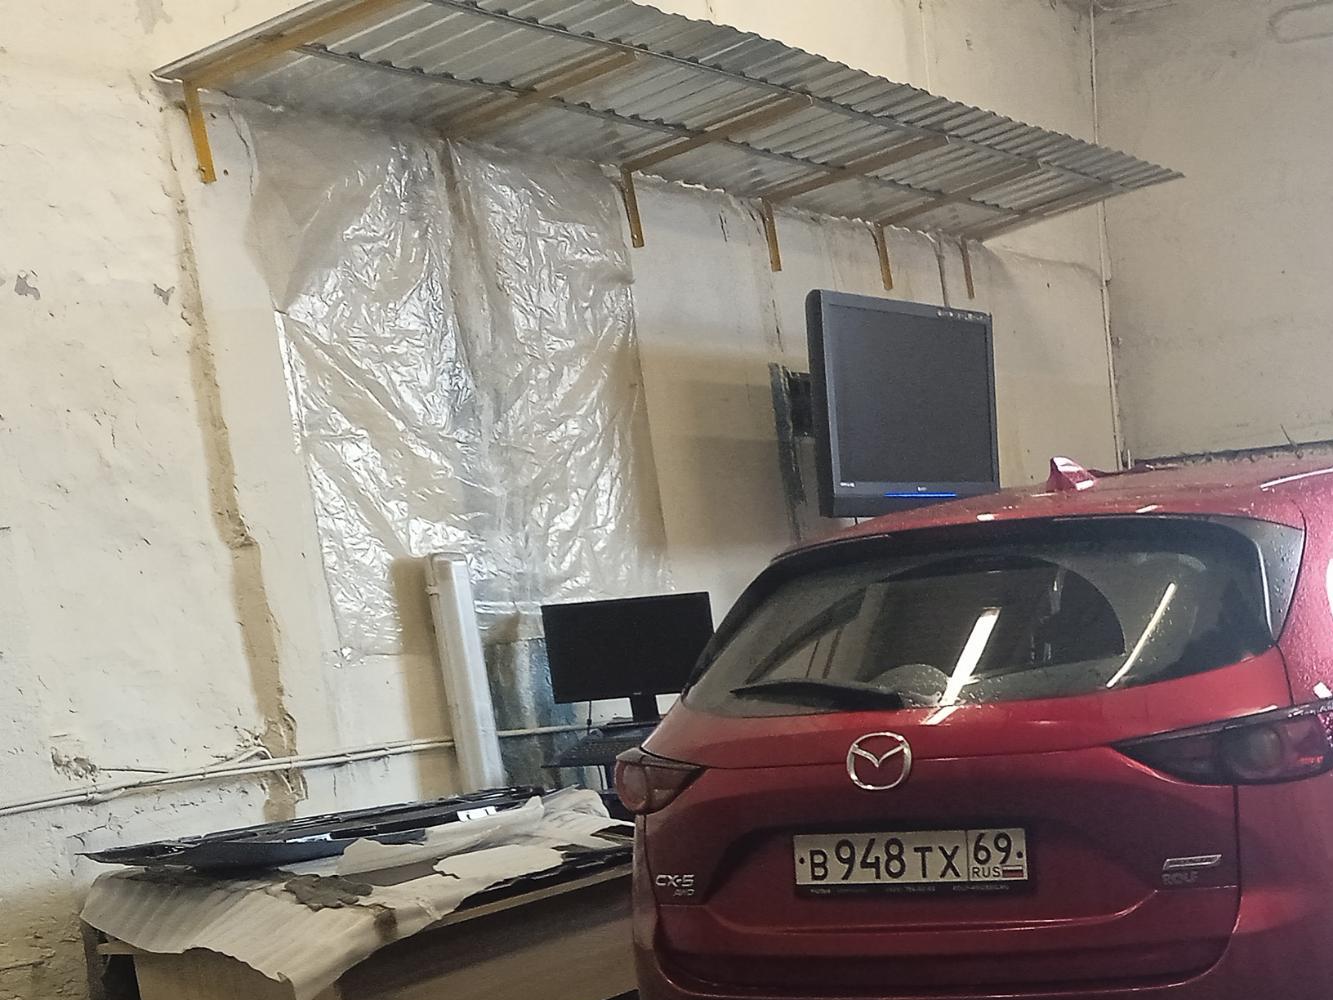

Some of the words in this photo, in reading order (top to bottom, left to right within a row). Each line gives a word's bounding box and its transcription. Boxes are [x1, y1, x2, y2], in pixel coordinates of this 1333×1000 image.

[973, 831, 1012, 865] 69
[971, 867, 1001, 879] RUS
[656, 874, 695, 887] CX-5
